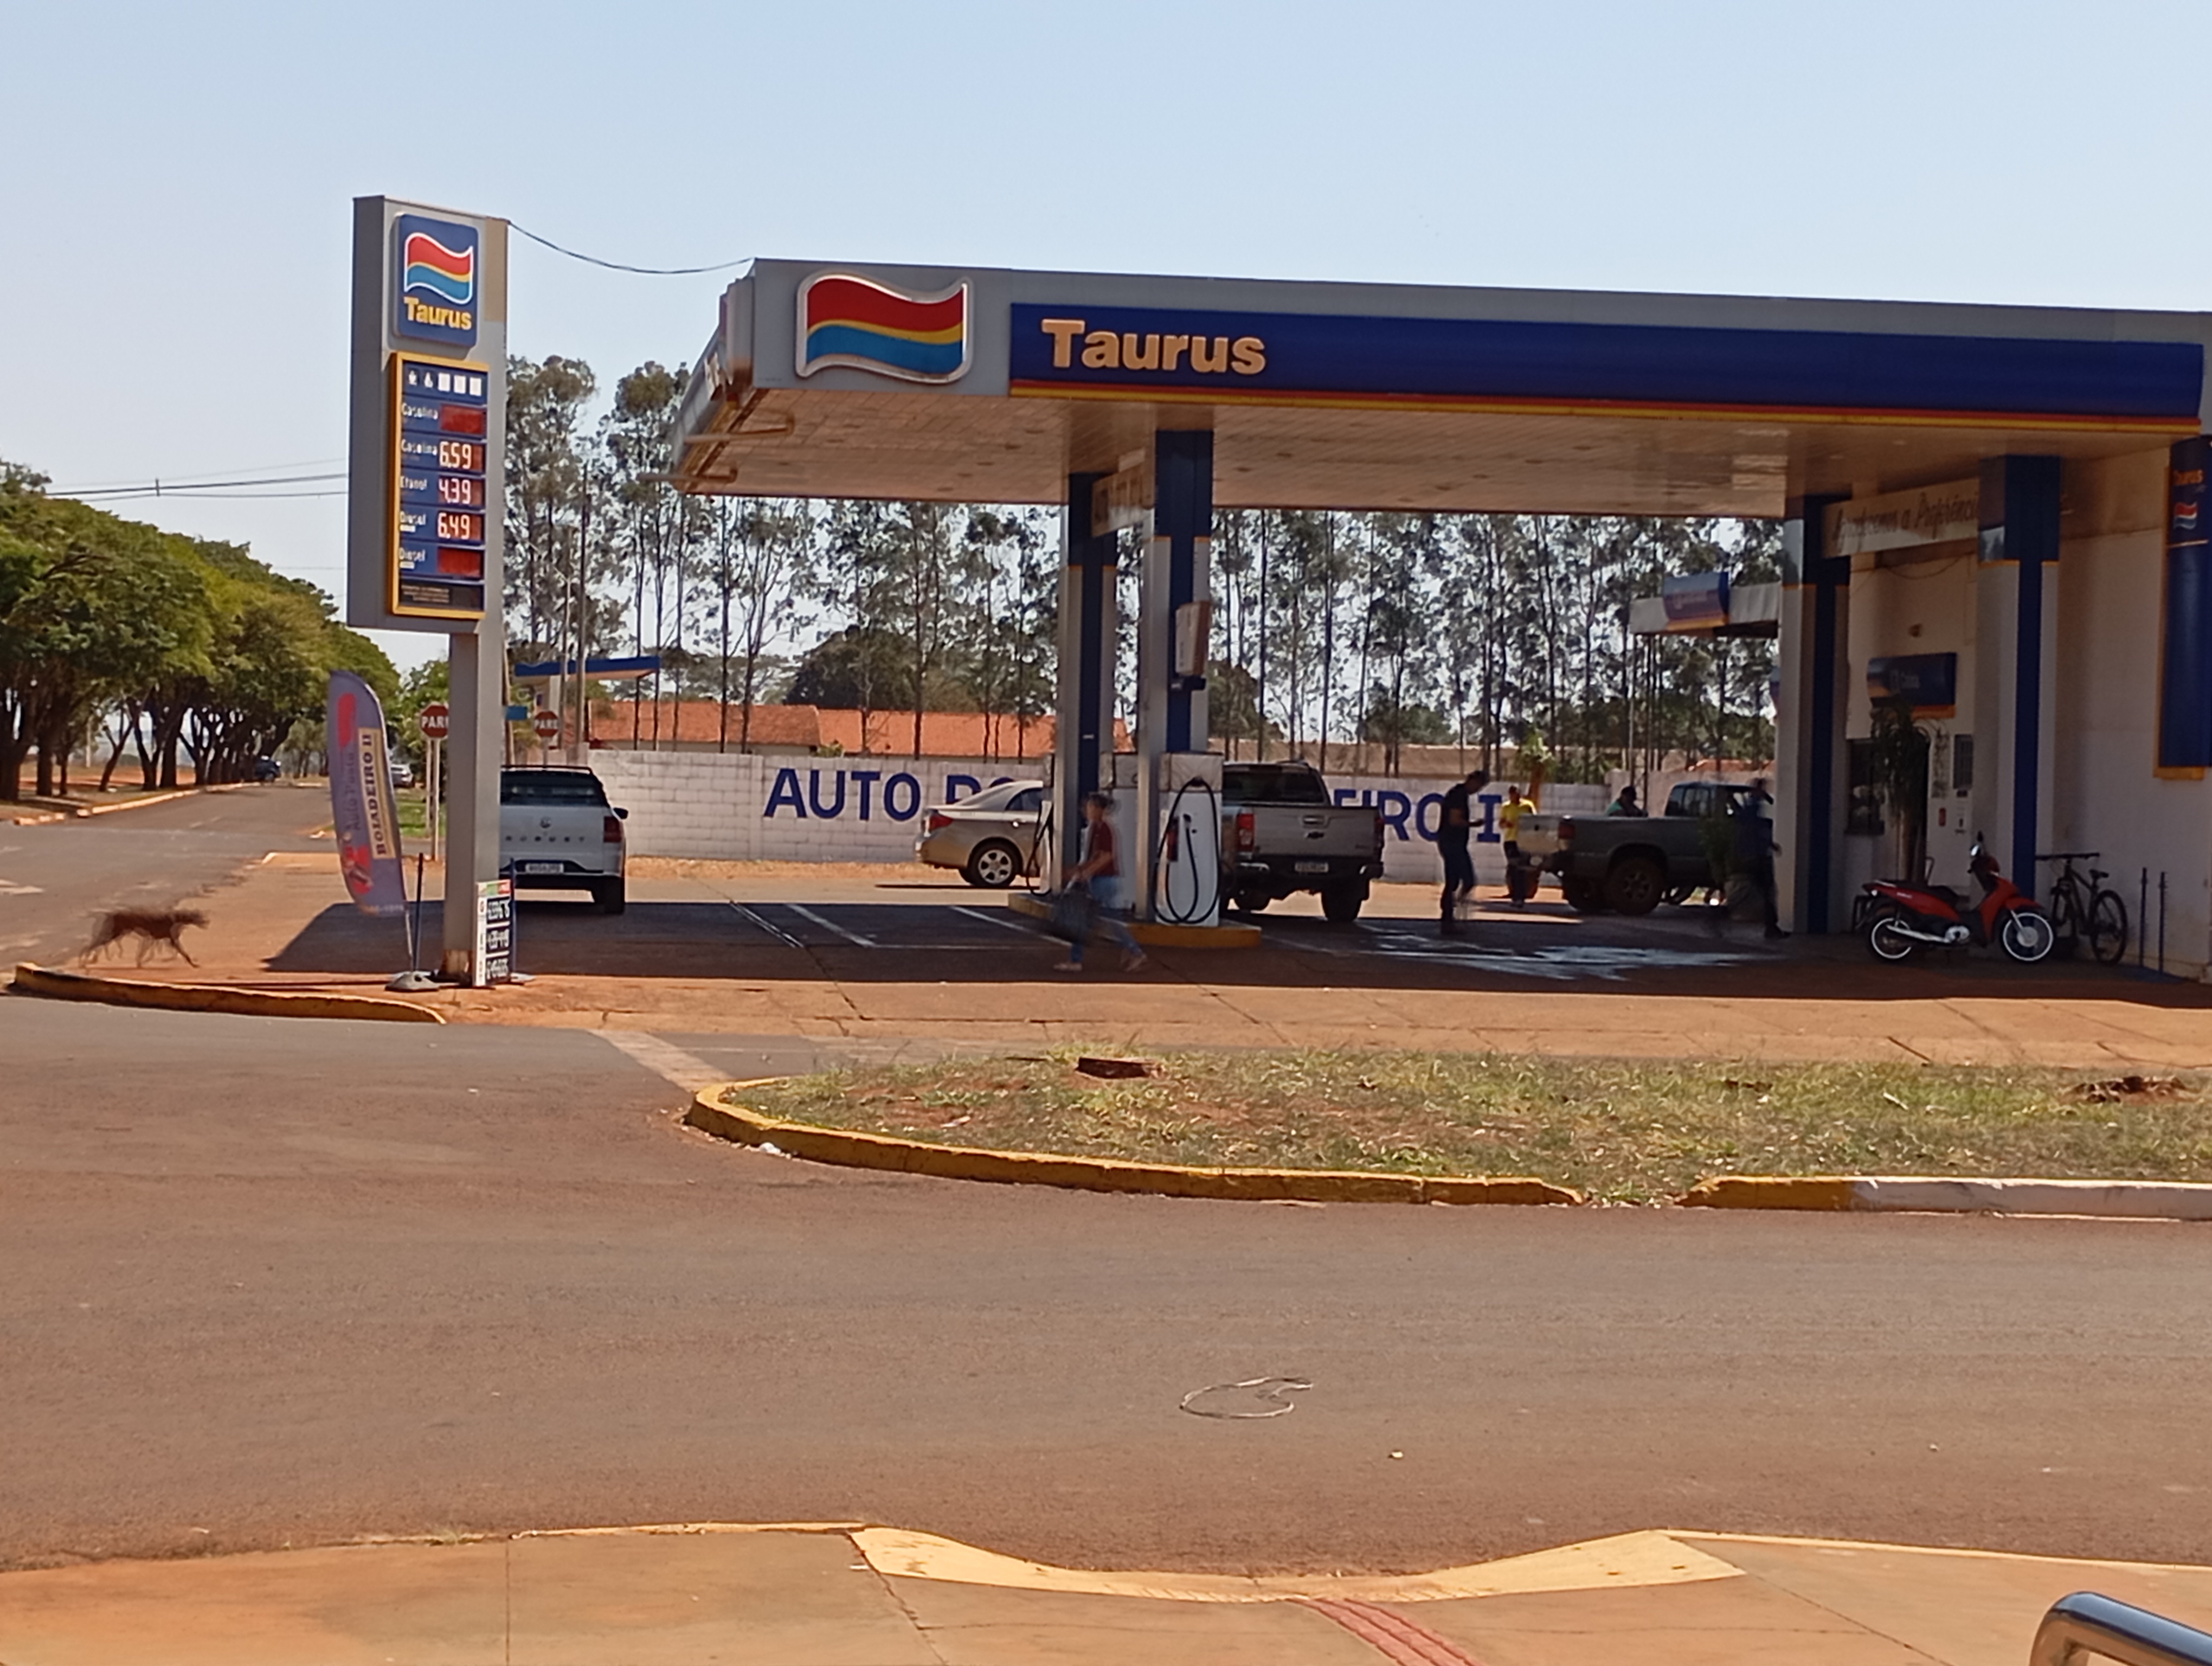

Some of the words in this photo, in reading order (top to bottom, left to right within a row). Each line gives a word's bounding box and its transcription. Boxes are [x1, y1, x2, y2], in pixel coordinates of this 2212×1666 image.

[404, 297, 472, 330] Taurus
[1041, 318, 1266, 374] Taurus
[439, 441, 472, 470] 6.59
[439, 478, 471, 504] 4.39
[438, 512, 470, 540] 6.49
[363, 752, 387, 855] BOIADEIRO
[763, 768, 921, 821] AUTO
